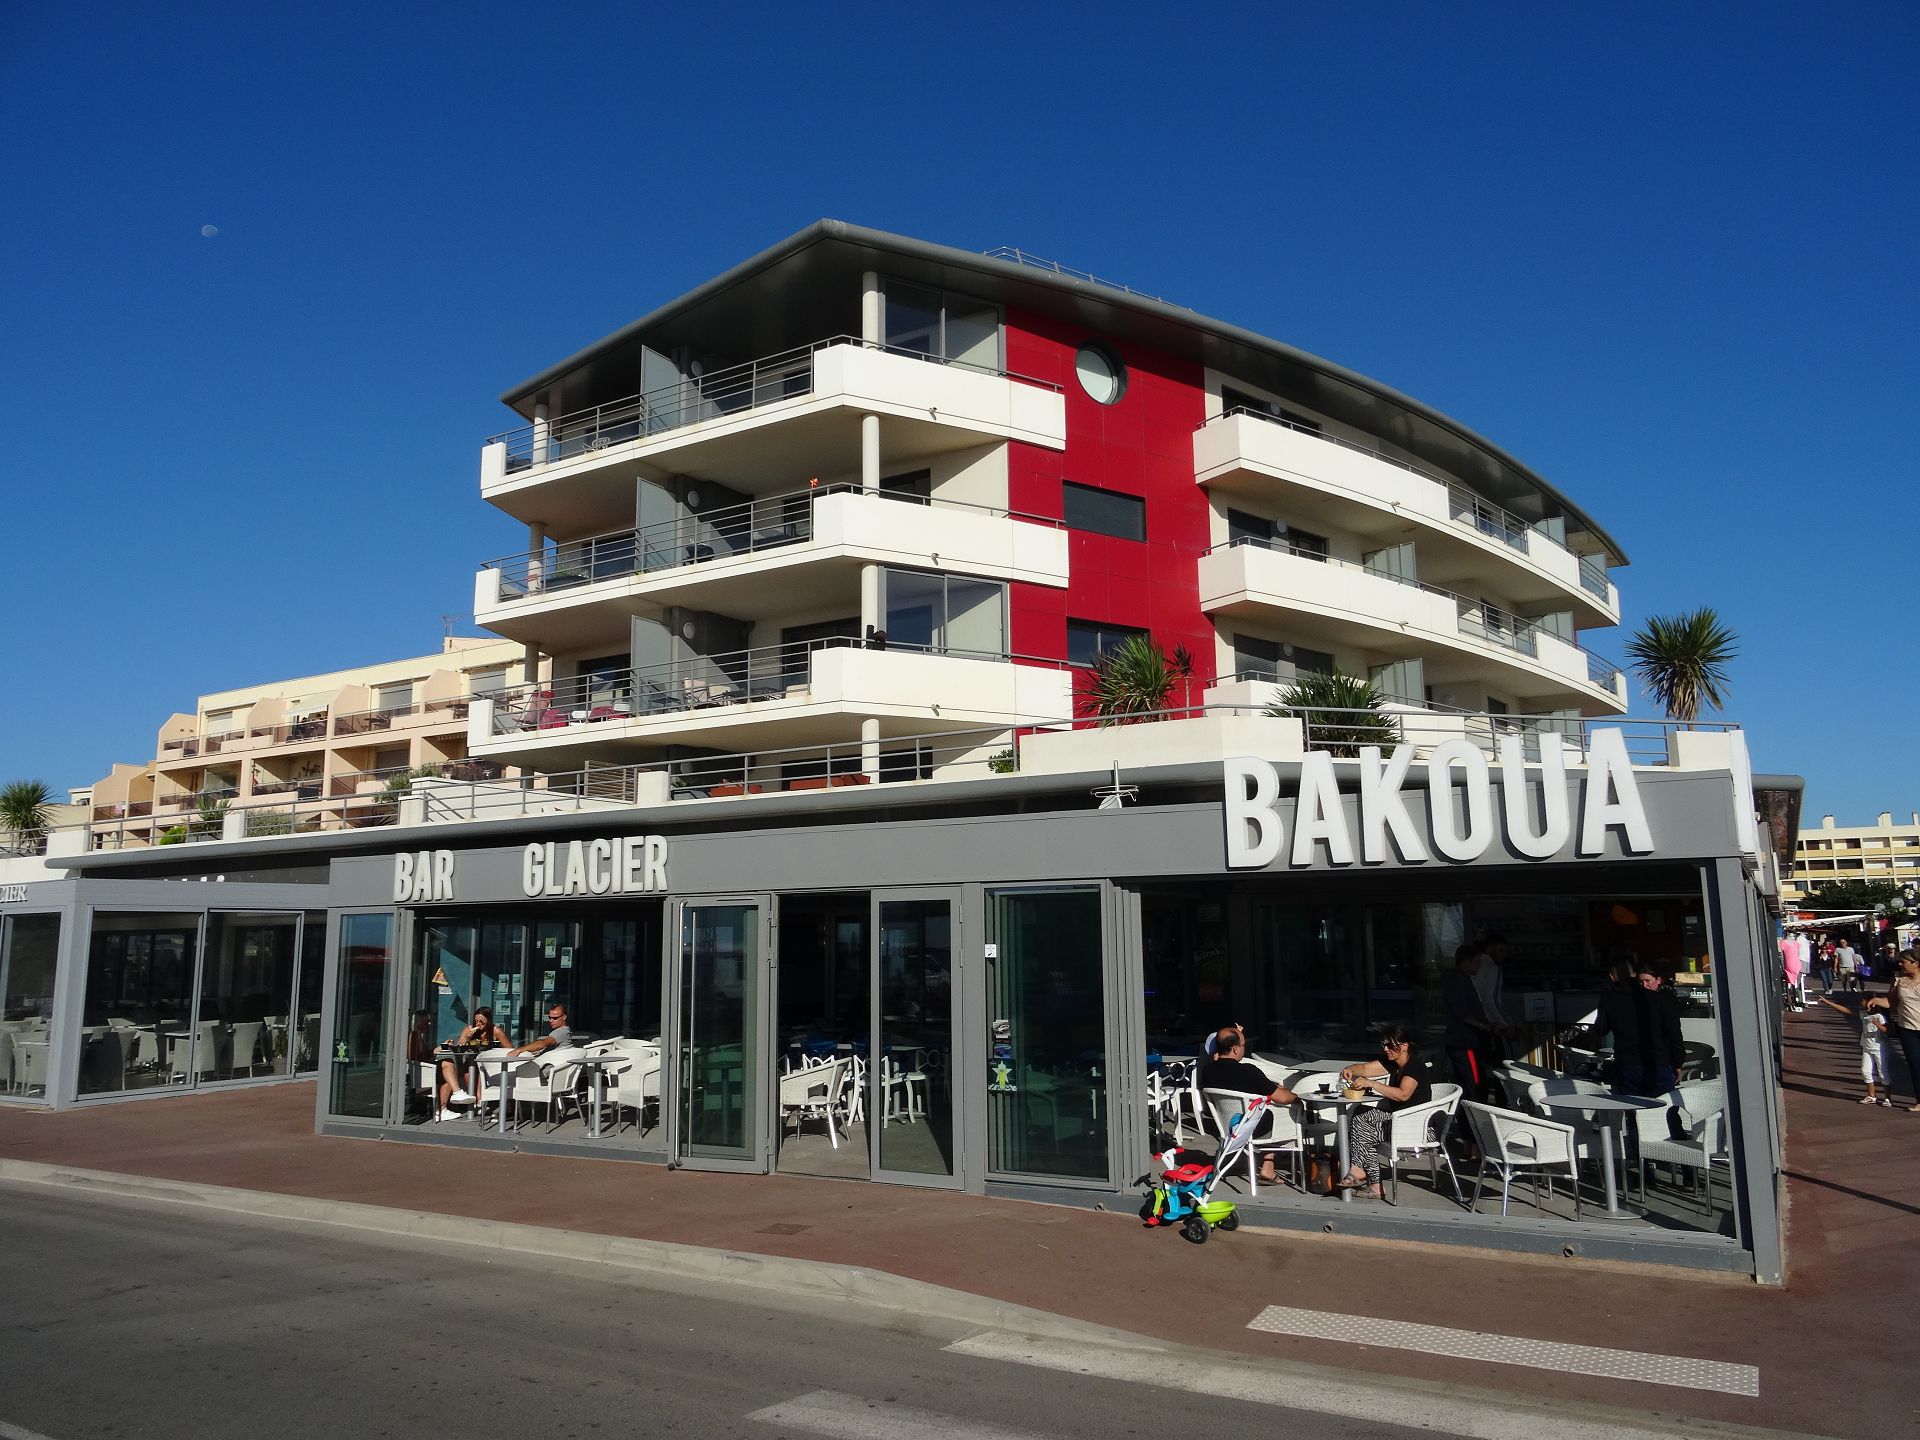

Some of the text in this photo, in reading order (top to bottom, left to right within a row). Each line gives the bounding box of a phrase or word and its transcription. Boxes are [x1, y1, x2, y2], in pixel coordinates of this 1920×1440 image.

[1223, 727, 1655, 868] BAKOUA
[394, 835, 668, 902] BAR GLACIER
